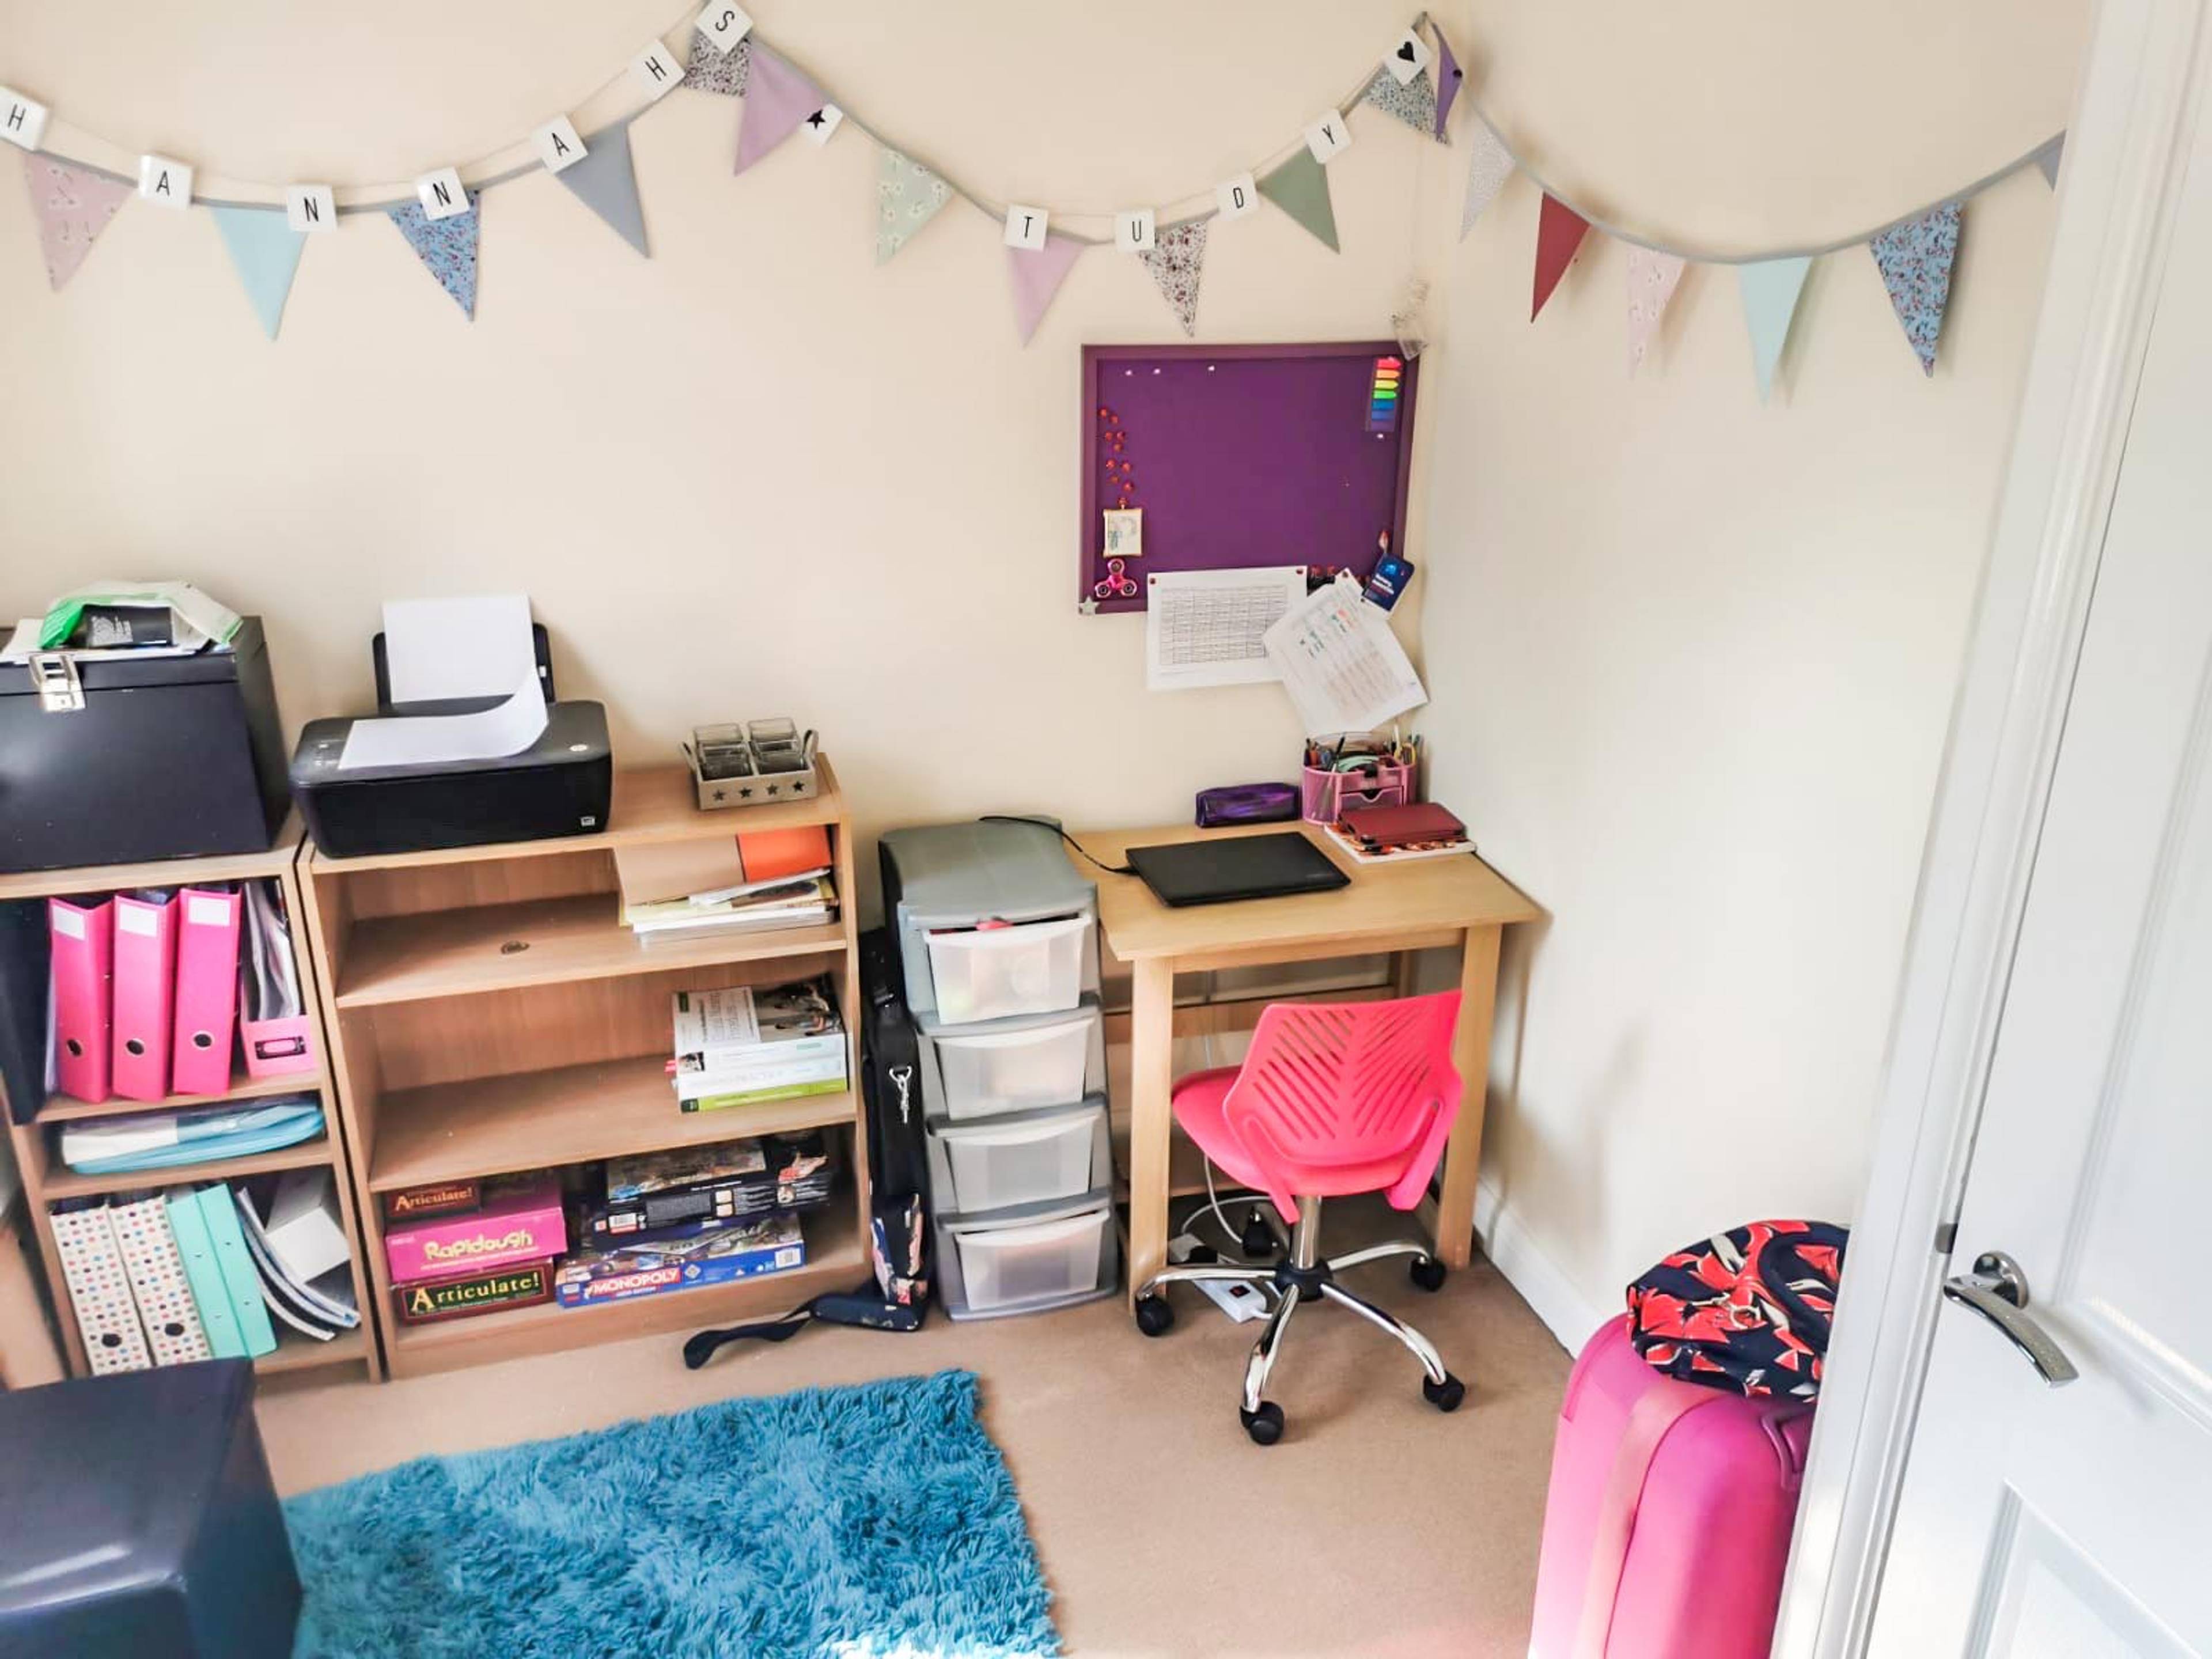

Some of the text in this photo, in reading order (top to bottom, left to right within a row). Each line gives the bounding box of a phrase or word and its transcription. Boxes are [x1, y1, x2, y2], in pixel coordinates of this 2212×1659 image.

[395, 1187, 473, 1211] Articulate!
[423, 1229, 533, 1260] Rapidough
[410, 1271, 540, 1312] Articulate!
[591, 1268, 679, 1295] MONOPOLY
